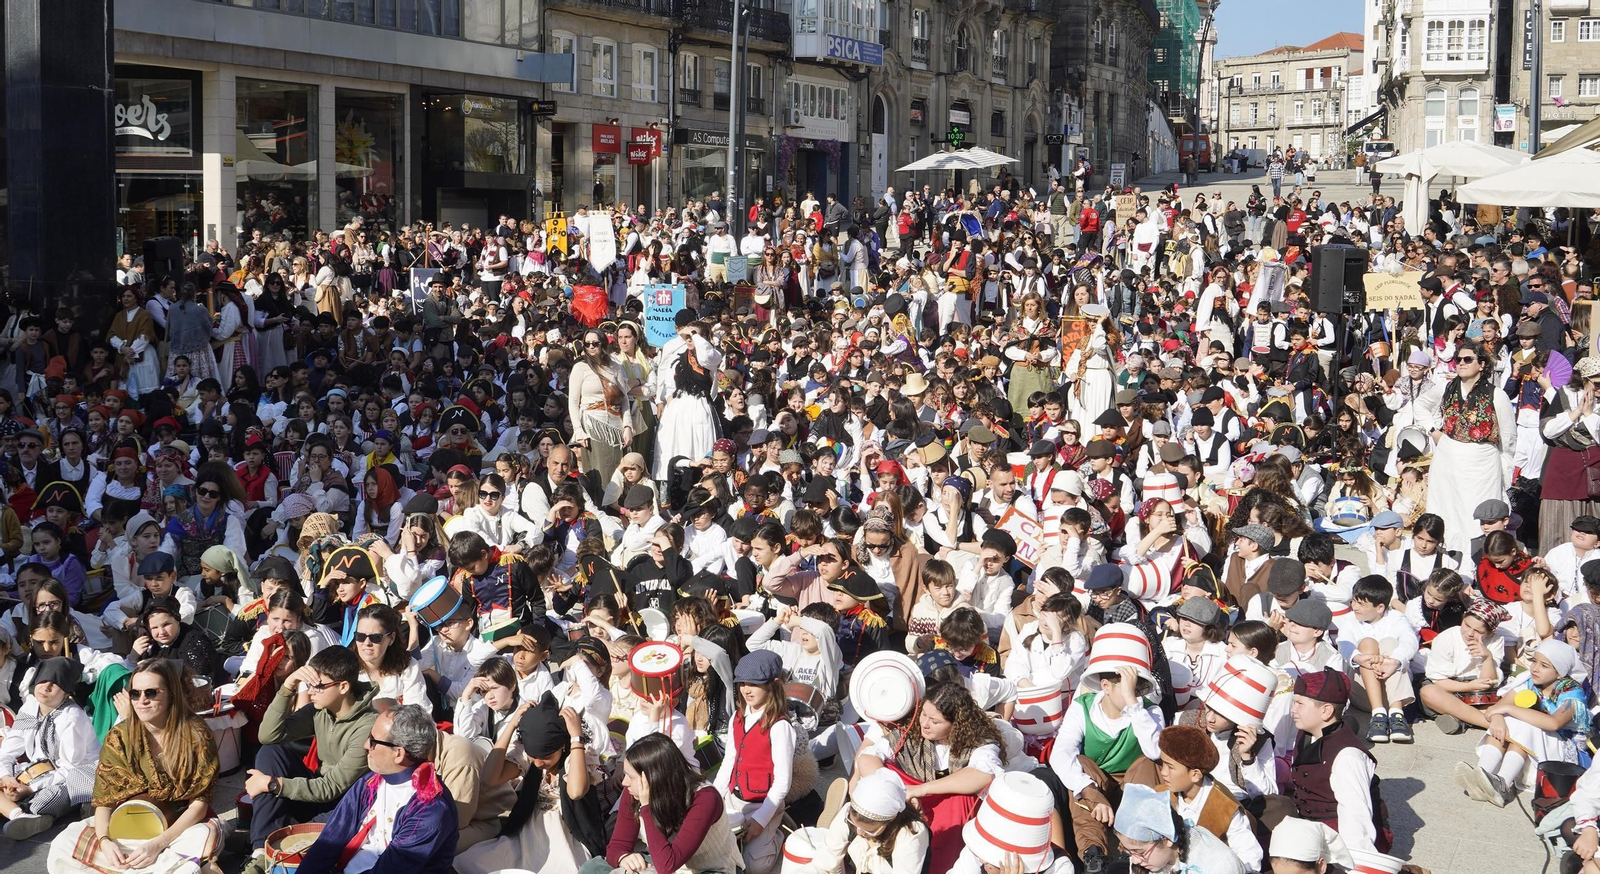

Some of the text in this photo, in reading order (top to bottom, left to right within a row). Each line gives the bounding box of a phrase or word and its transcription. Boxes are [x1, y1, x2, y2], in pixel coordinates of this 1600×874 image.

[827, 36, 861, 60] PSICA
[692, 132, 702, 142] AS
[451, 409, 464, 419] N
[1281, 427, 1292, 436] N
[46, 489, 70, 503] N
[333, 555, 361, 570] N
[494, 573, 506, 586] N
[837, 570, 857, 579] N
